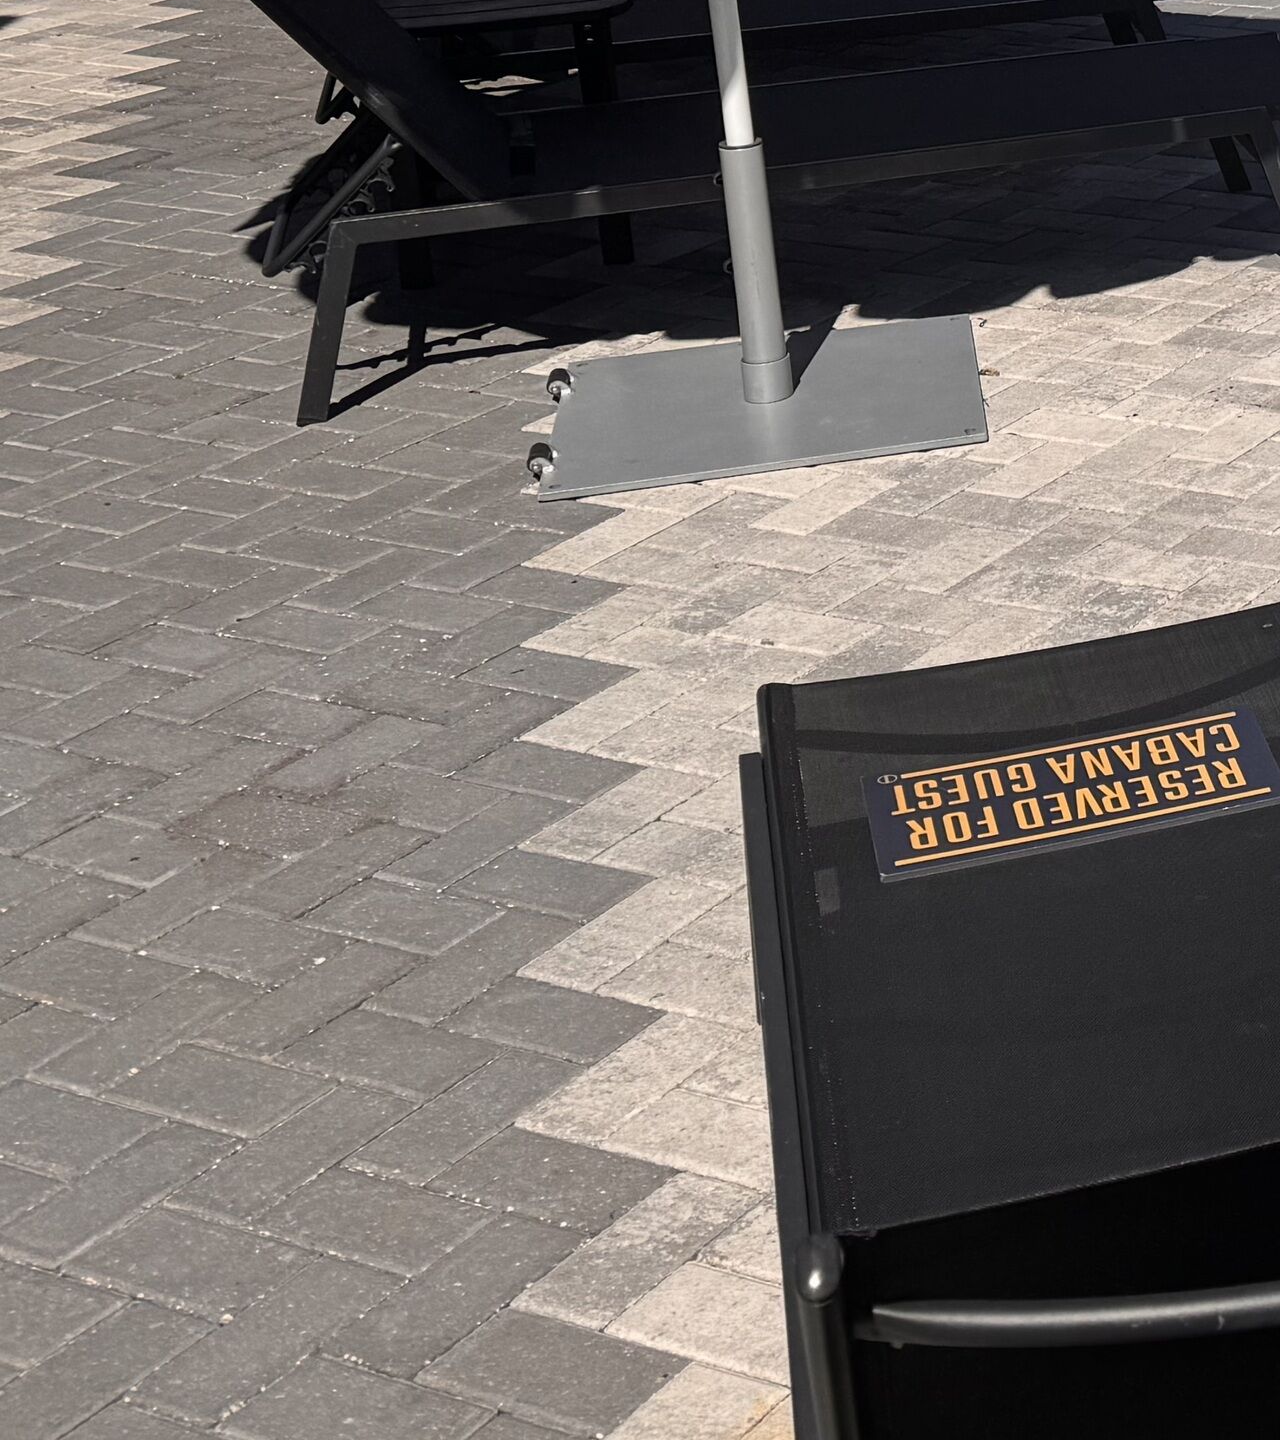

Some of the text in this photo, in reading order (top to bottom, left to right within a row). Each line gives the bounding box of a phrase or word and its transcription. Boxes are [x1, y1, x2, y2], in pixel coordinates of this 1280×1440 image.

[891, 722, 1241, 817] CABANA GUEST
[905, 756, 1248, 851] RESERVED FOR
